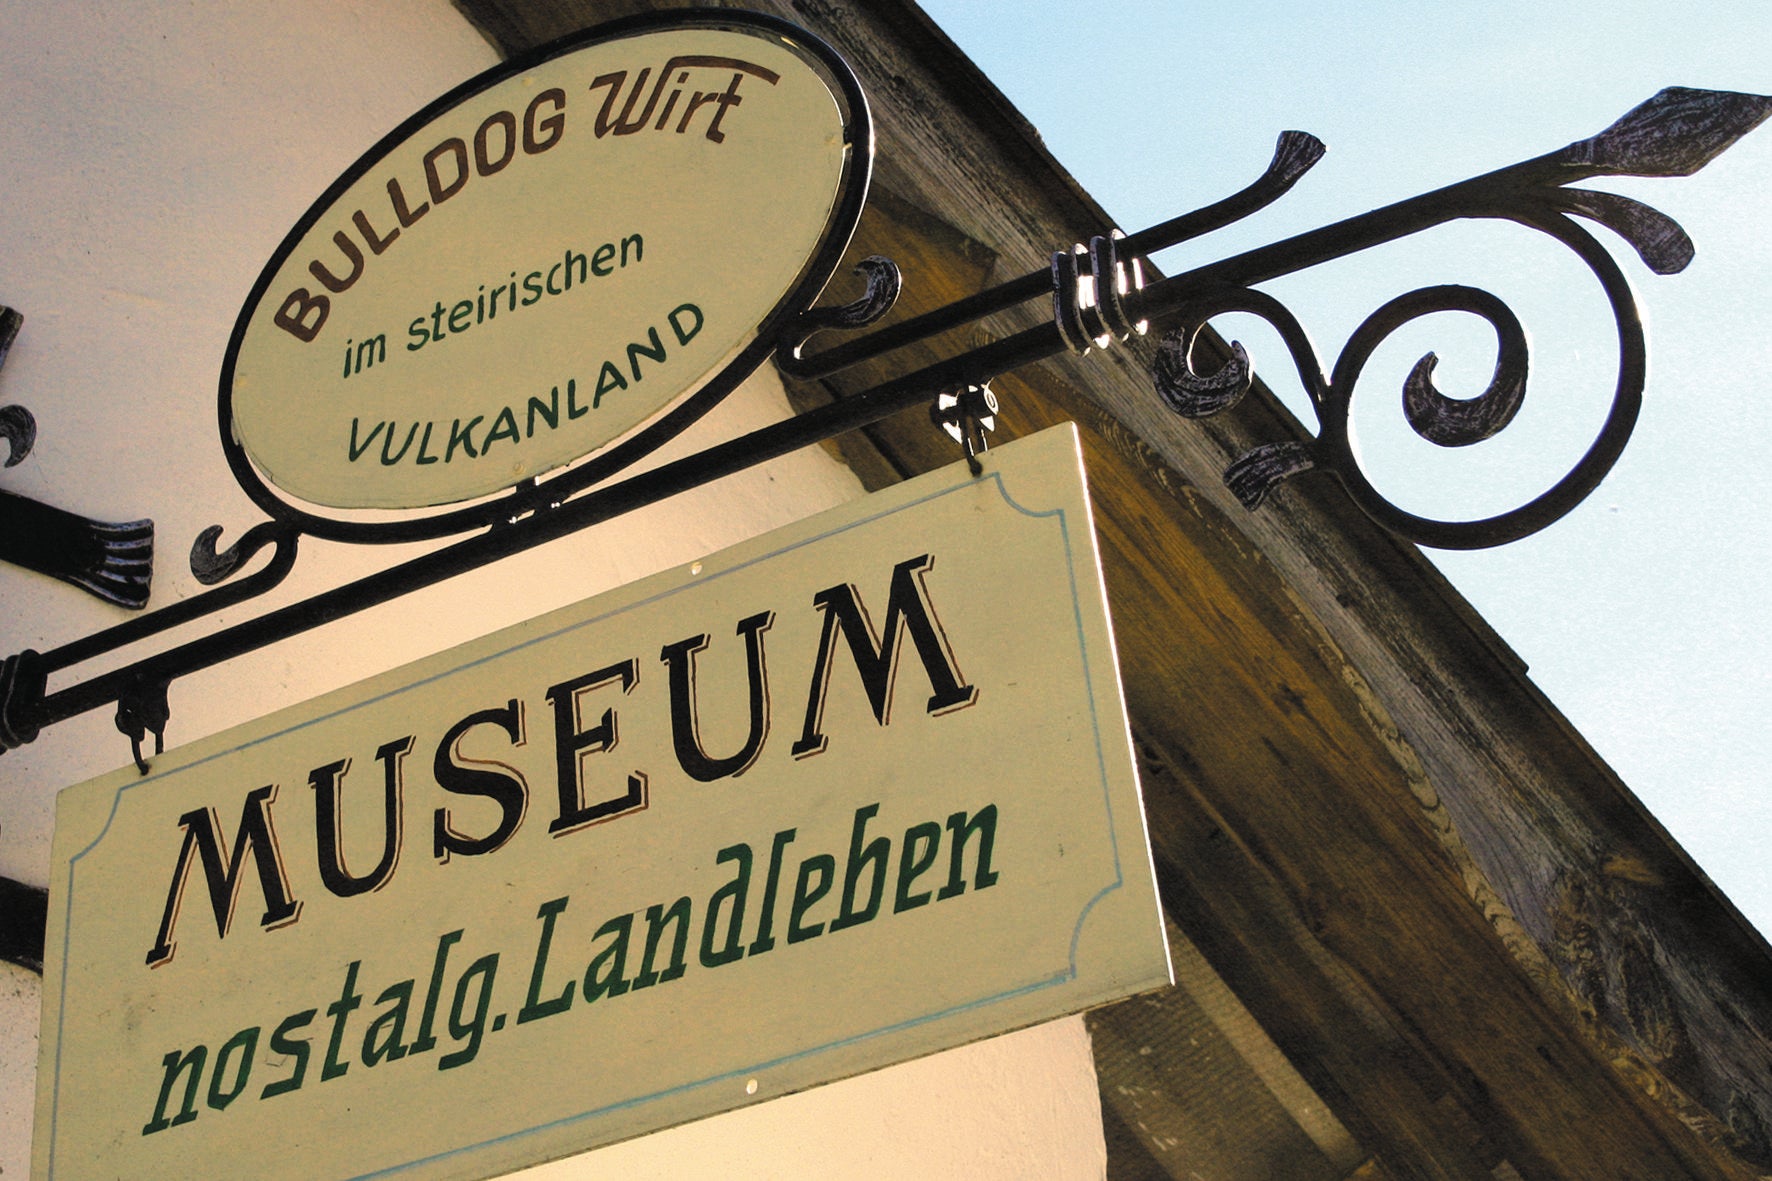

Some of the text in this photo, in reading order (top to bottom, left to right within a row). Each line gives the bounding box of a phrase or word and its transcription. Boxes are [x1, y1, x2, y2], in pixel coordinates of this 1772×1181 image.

[274, 55, 780, 343] BULLDOG Wirt
[343, 233, 644, 379] im steirischen
[348, 303, 704, 466] VULKANLAND
[145, 553, 978, 969] MUSEUM
